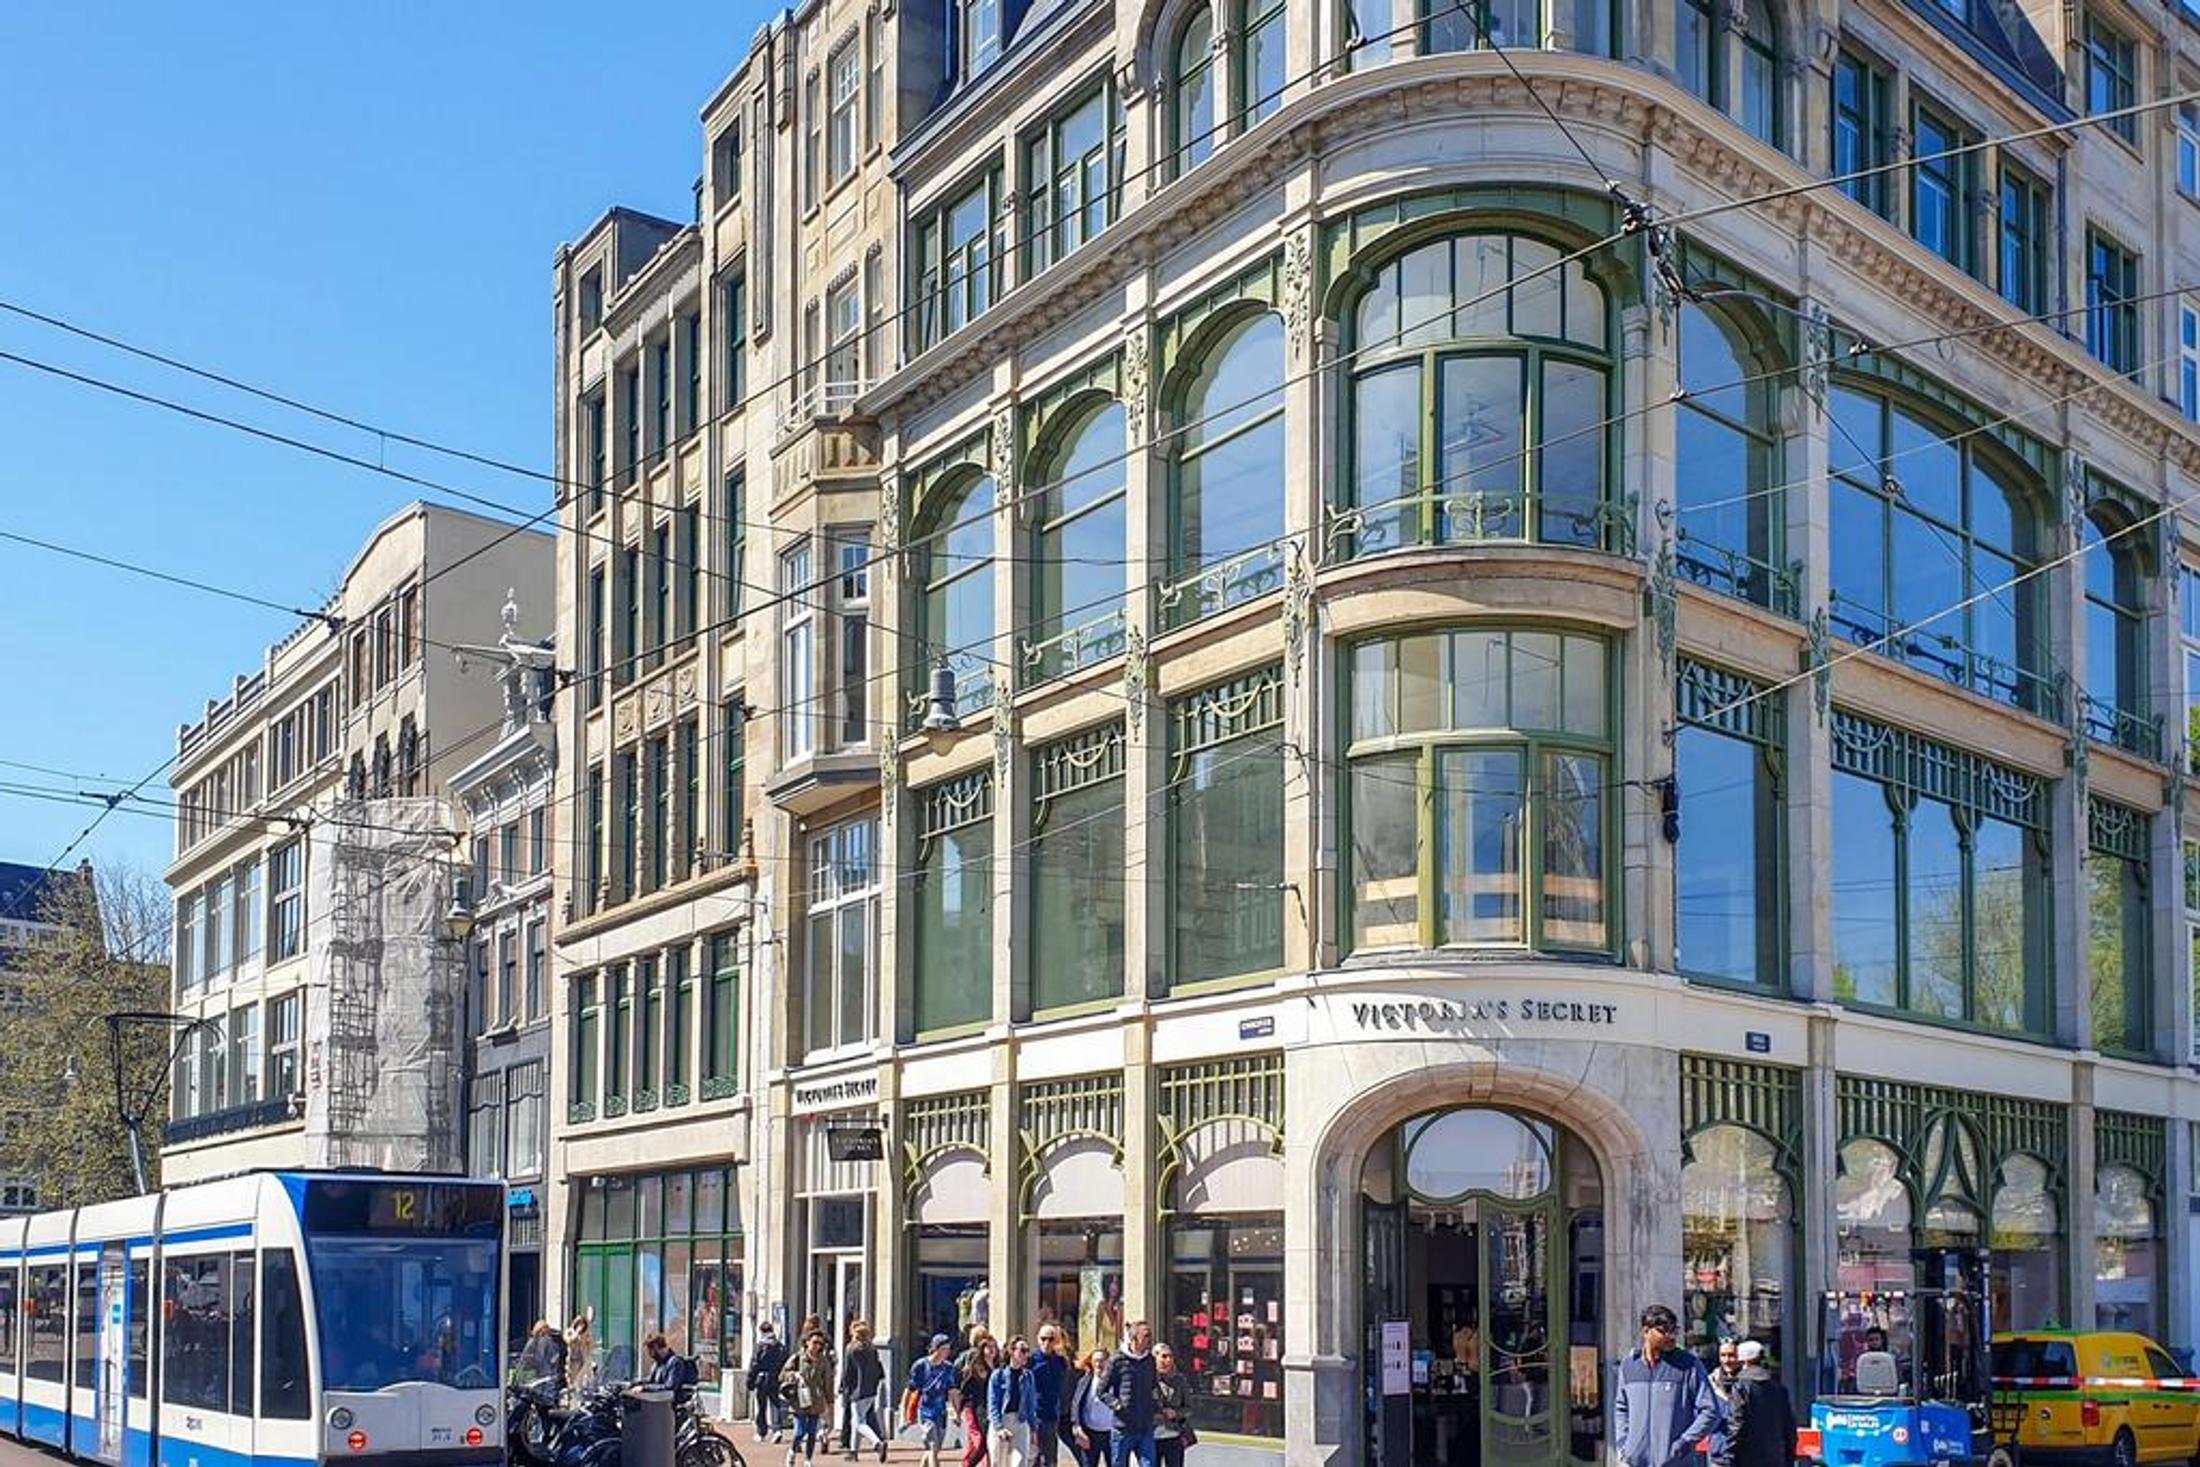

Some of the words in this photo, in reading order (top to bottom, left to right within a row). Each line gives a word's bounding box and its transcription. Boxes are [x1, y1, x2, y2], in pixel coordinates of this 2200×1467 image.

[1352, 1000, 1508, 1022] VICTORIA'S
[1521, 999, 1617, 1024] SECRET
[393, 1189, 414, 1220] 12
